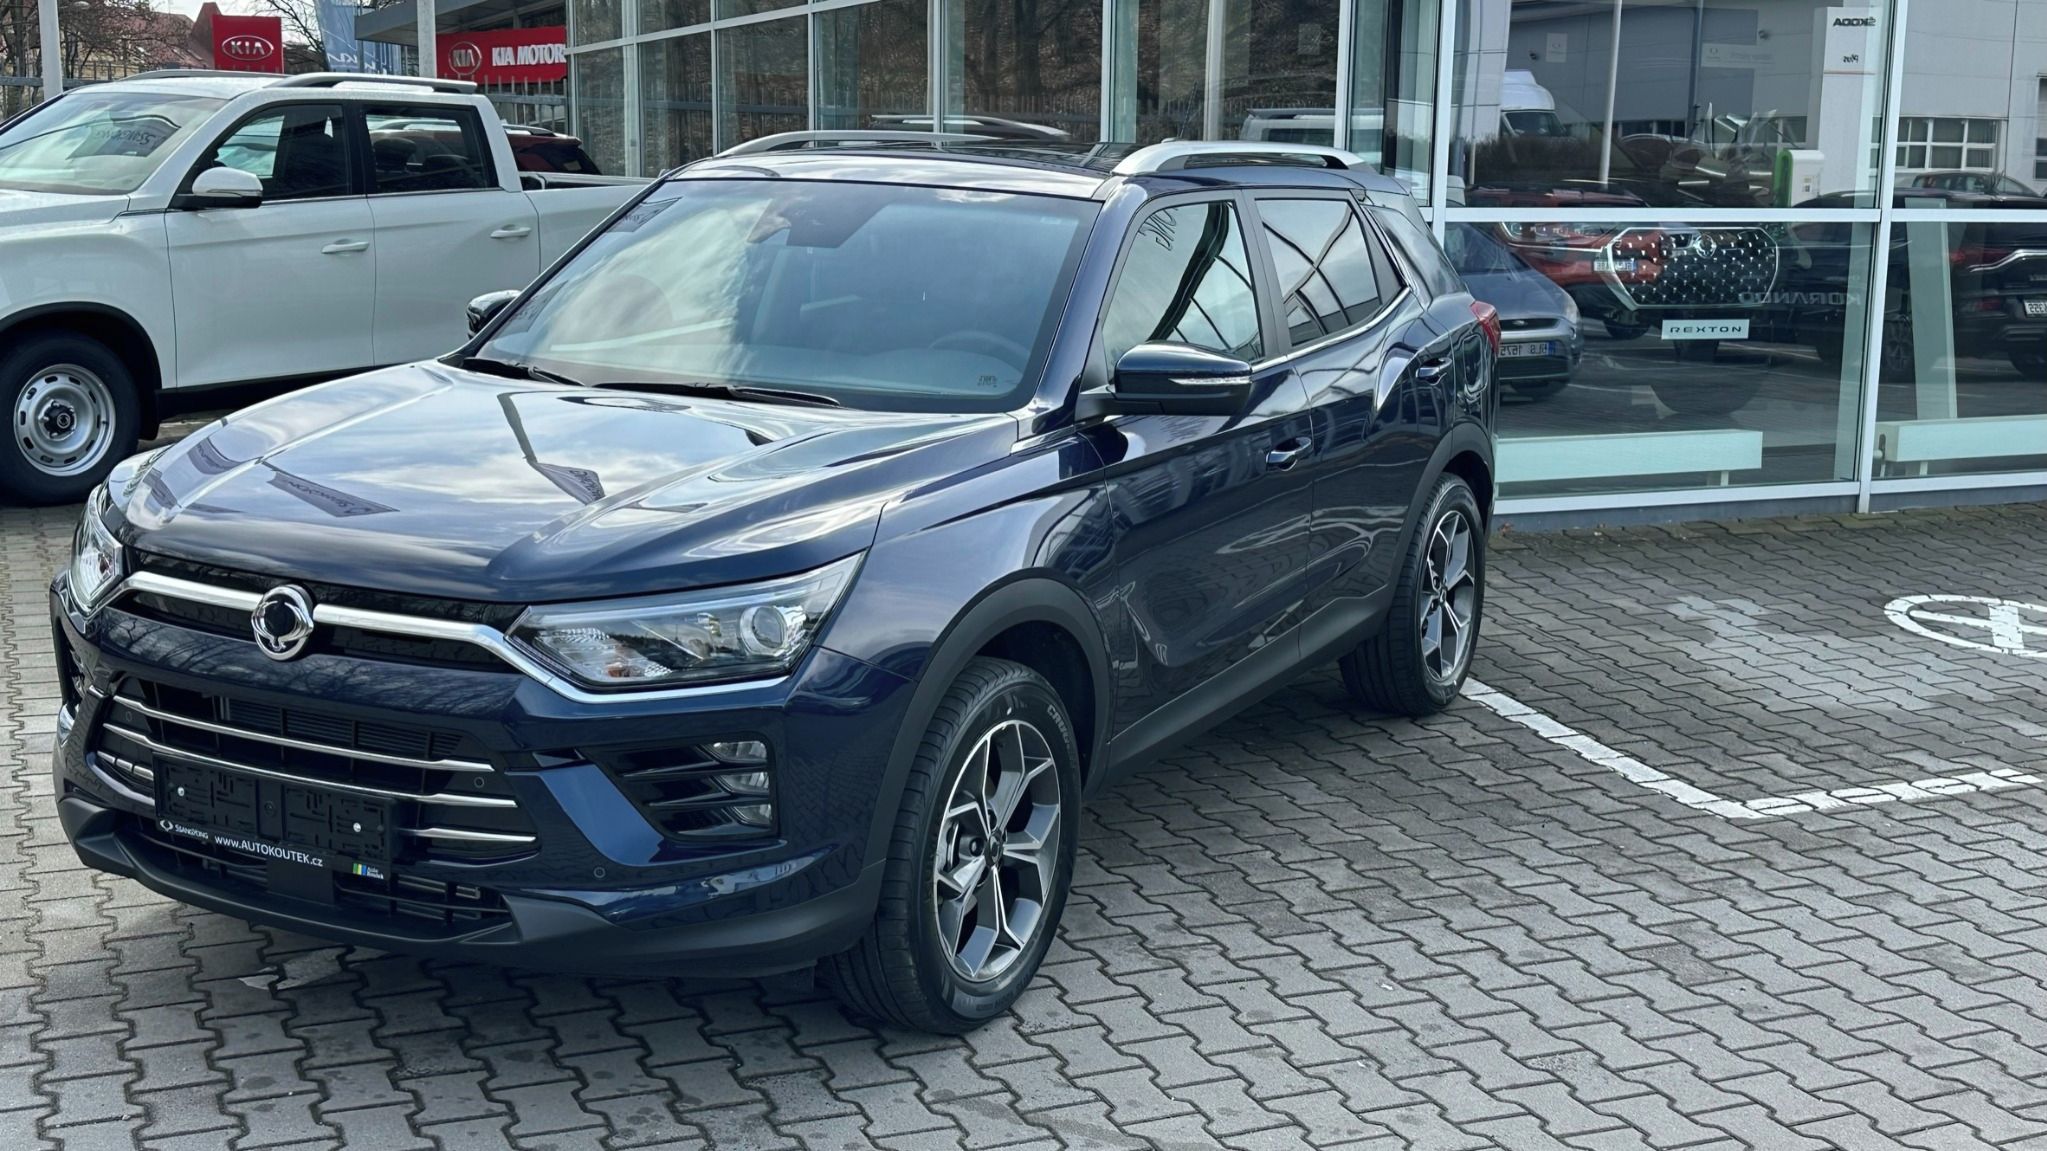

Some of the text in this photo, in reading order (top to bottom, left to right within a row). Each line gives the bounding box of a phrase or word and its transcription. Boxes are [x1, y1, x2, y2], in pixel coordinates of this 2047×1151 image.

[231, 41, 265, 55] KIA
[492, 46, 515, 67] KIA
[453, 49, 475, 67] KIA
[214, 835, 323, 867] www.AUTOKOUTEK.cz
